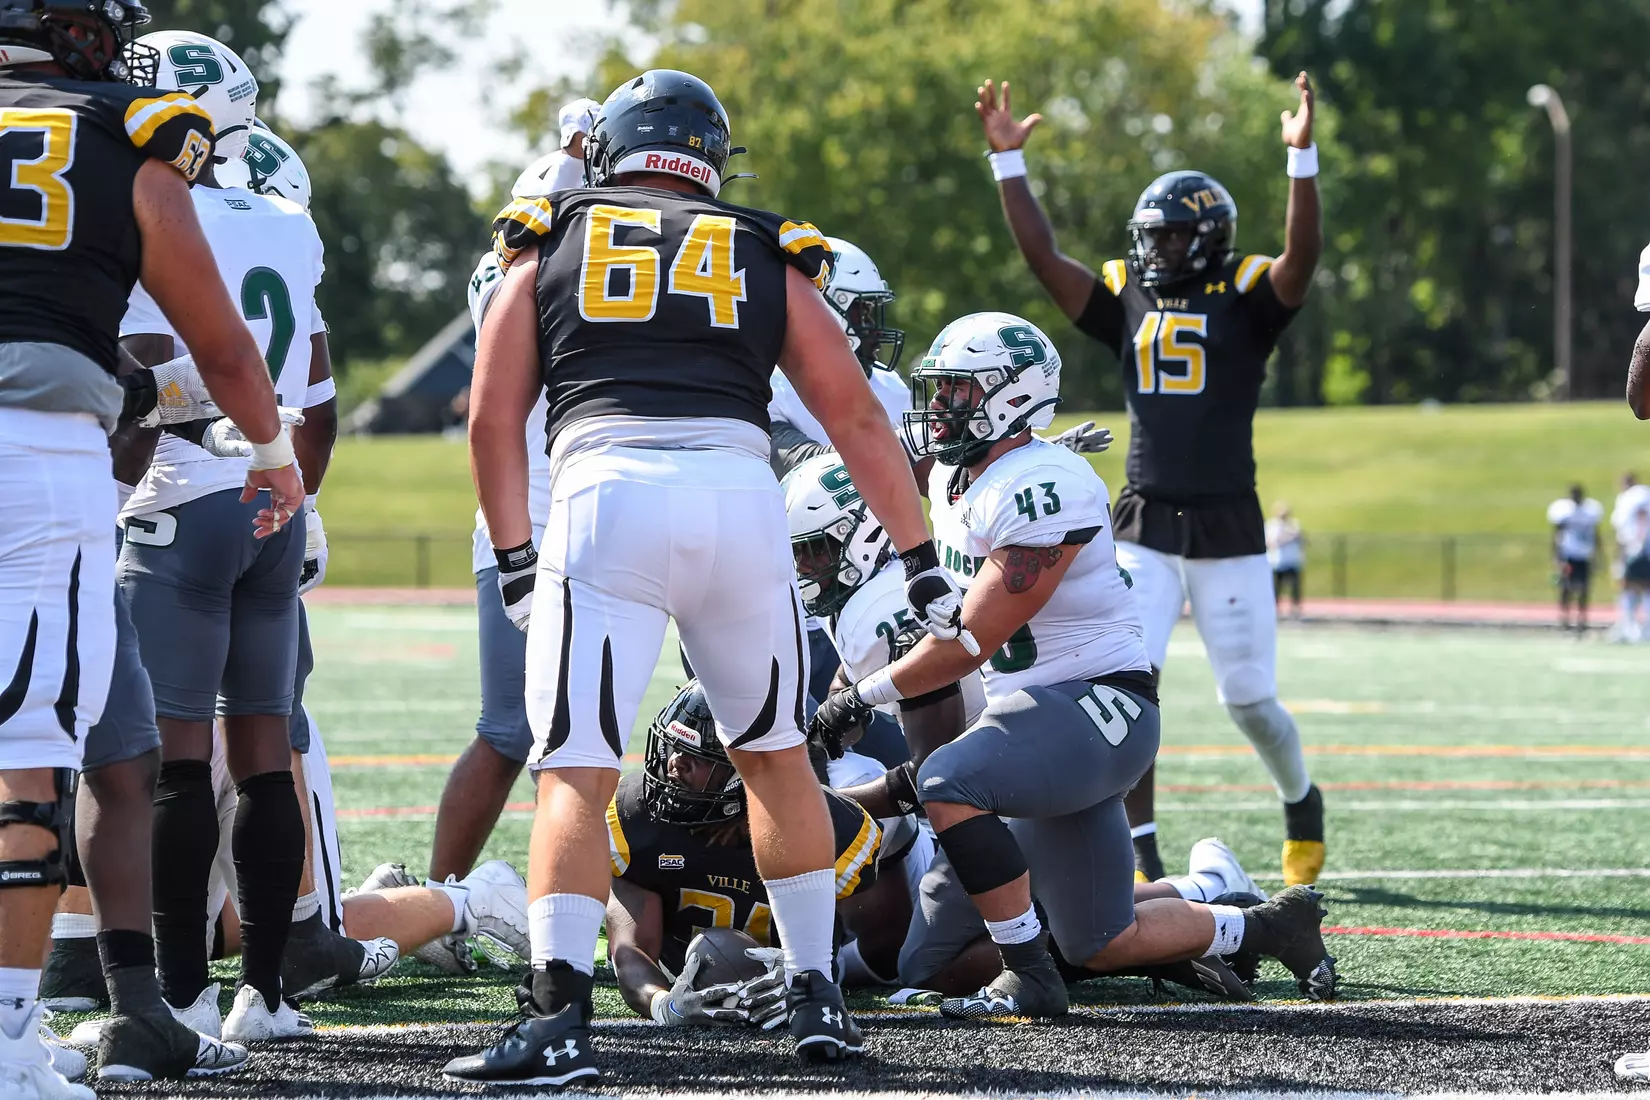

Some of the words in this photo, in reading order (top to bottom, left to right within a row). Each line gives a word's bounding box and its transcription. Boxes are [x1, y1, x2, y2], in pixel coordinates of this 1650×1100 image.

[167, 44, 224, 88] S
[688, 136, 702, 148] 87
[644, 153, 712, 184] Riddell
[578, 204, 748, 330] 64
[997, 324, 1048, 369] S
[1132, 311, 1208, 396] 15
[1014, 481, 1062, 522] 43
[670, 723, 697, 742] Riddell
[1077, 683, 1143, 747] S
[9, 871, 42, 879] BREG
[706, 874, 751, 894] VILLE
